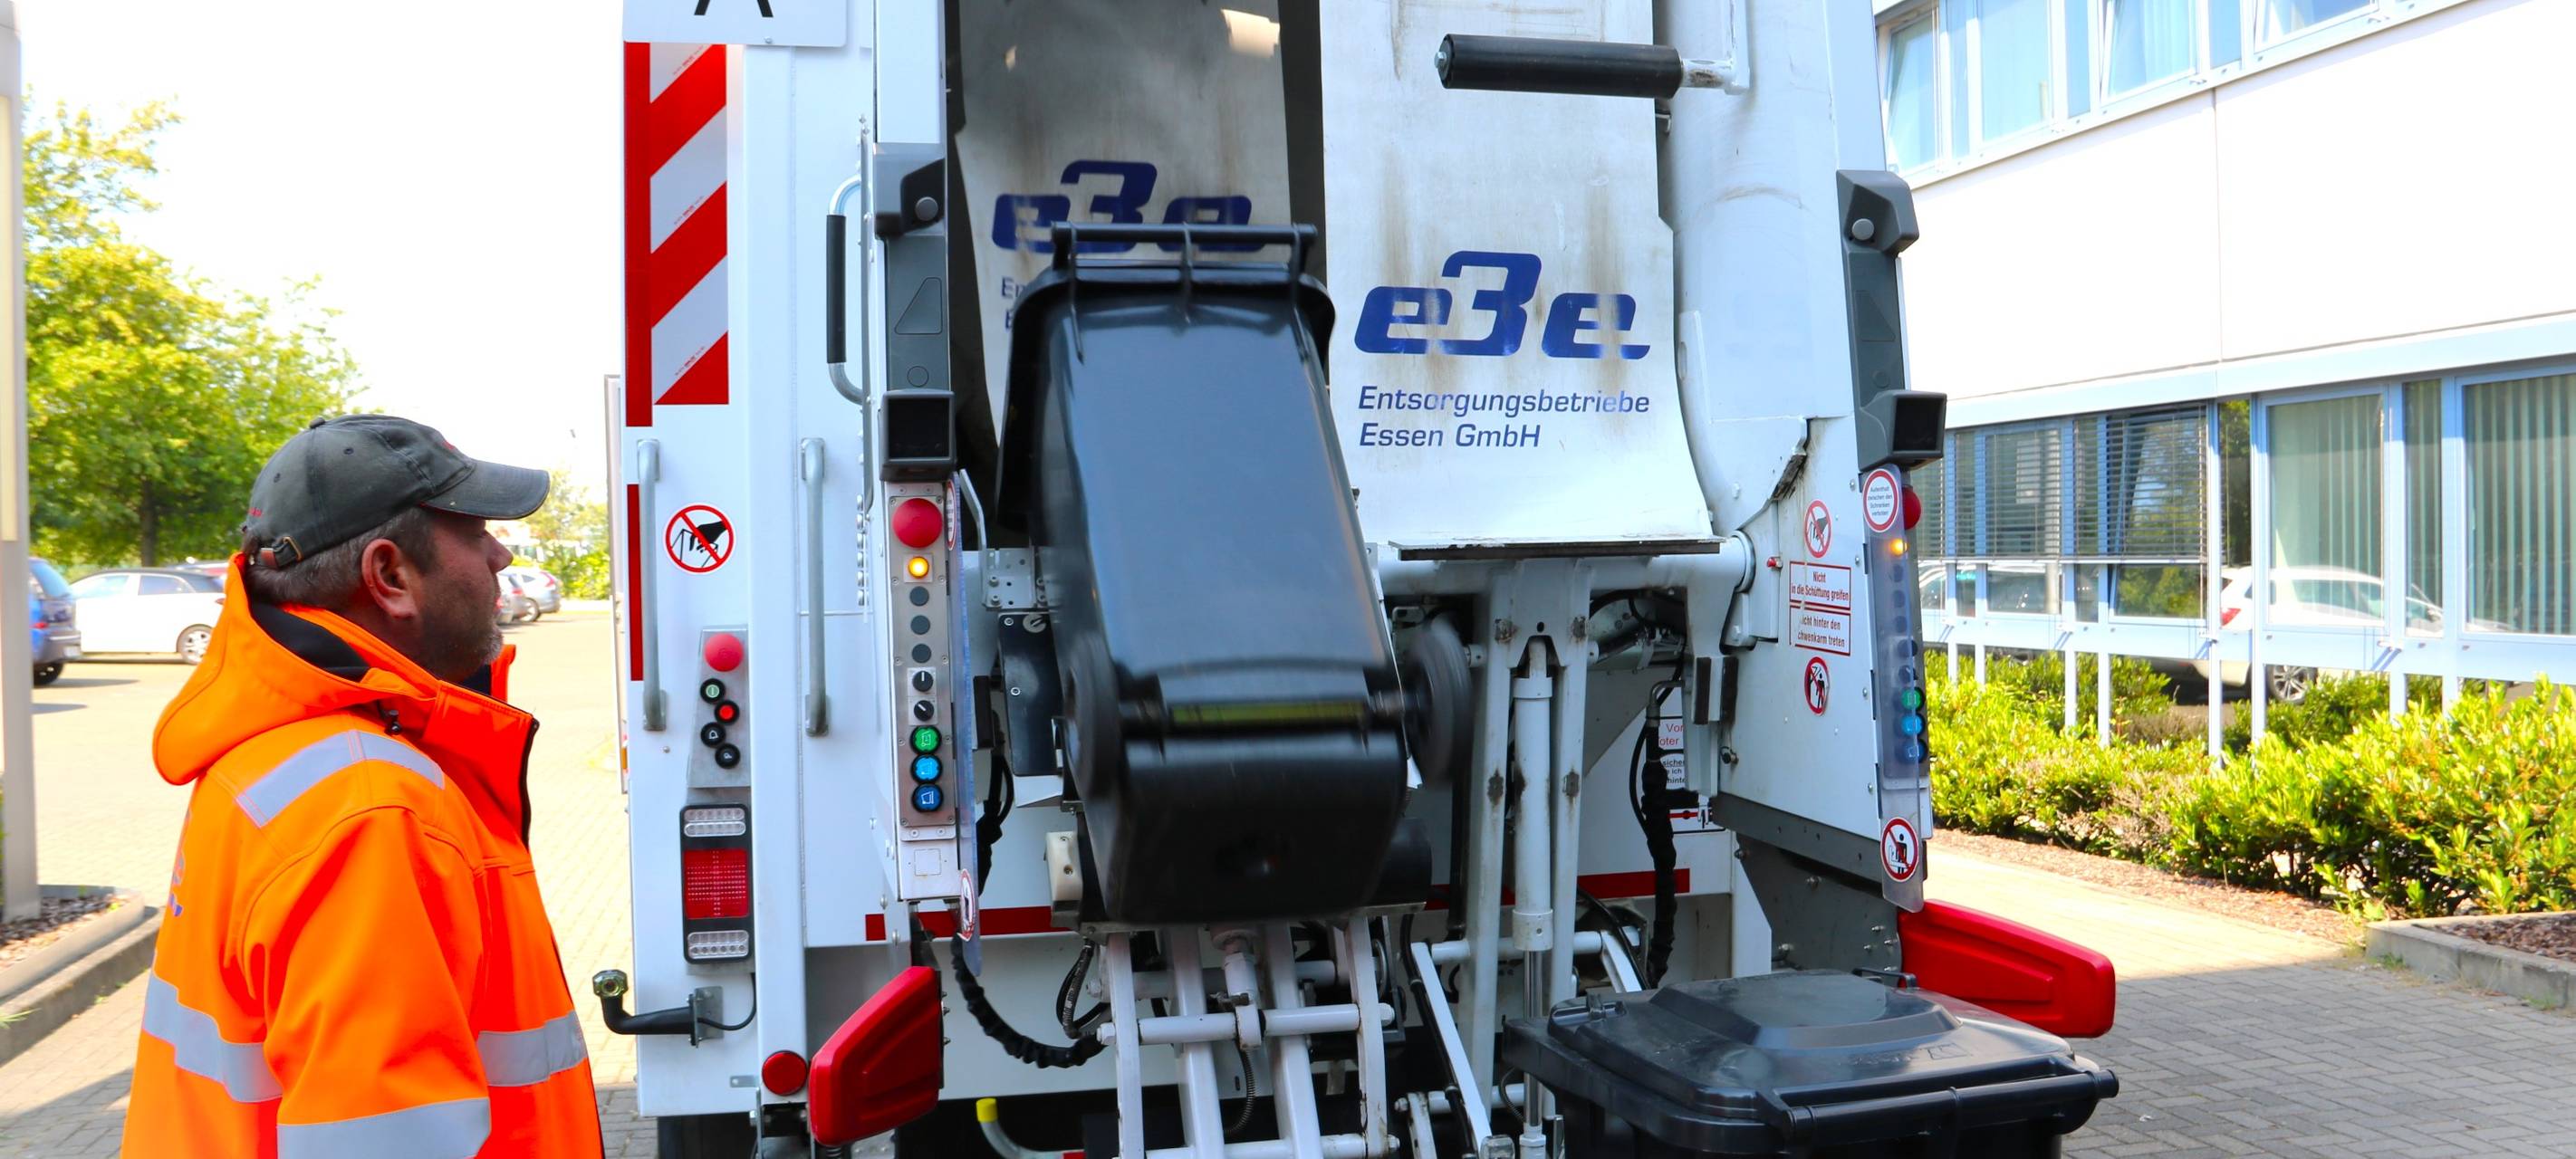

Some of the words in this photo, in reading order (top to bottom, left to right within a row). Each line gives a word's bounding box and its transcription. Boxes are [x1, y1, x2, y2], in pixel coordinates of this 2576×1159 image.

[992, 159, 1266, 253] e3e
[1354, 250, 1651, 360] e3e
[1358, 385, 1651, 418] Entsorgungsbetriebe
[1359, 422, 1444, 446] Essen
[1456, 423, 1541, 447] GmbH
[1812, 571, 1826, 583] Nicht
[1791, 582, 1796, 593] in
[1797, 584, 1805, 595] die
[1805, 585, 1830, 600] Schüttung
[1831, 589, 1849, 601] greifen
[1813, 616, 1830, 628] hinter
[1831, 618, 1841, 630] den
[1797, 629, 1828, 643] chwenkarm
[1828, 636, 1845, 647] treten
